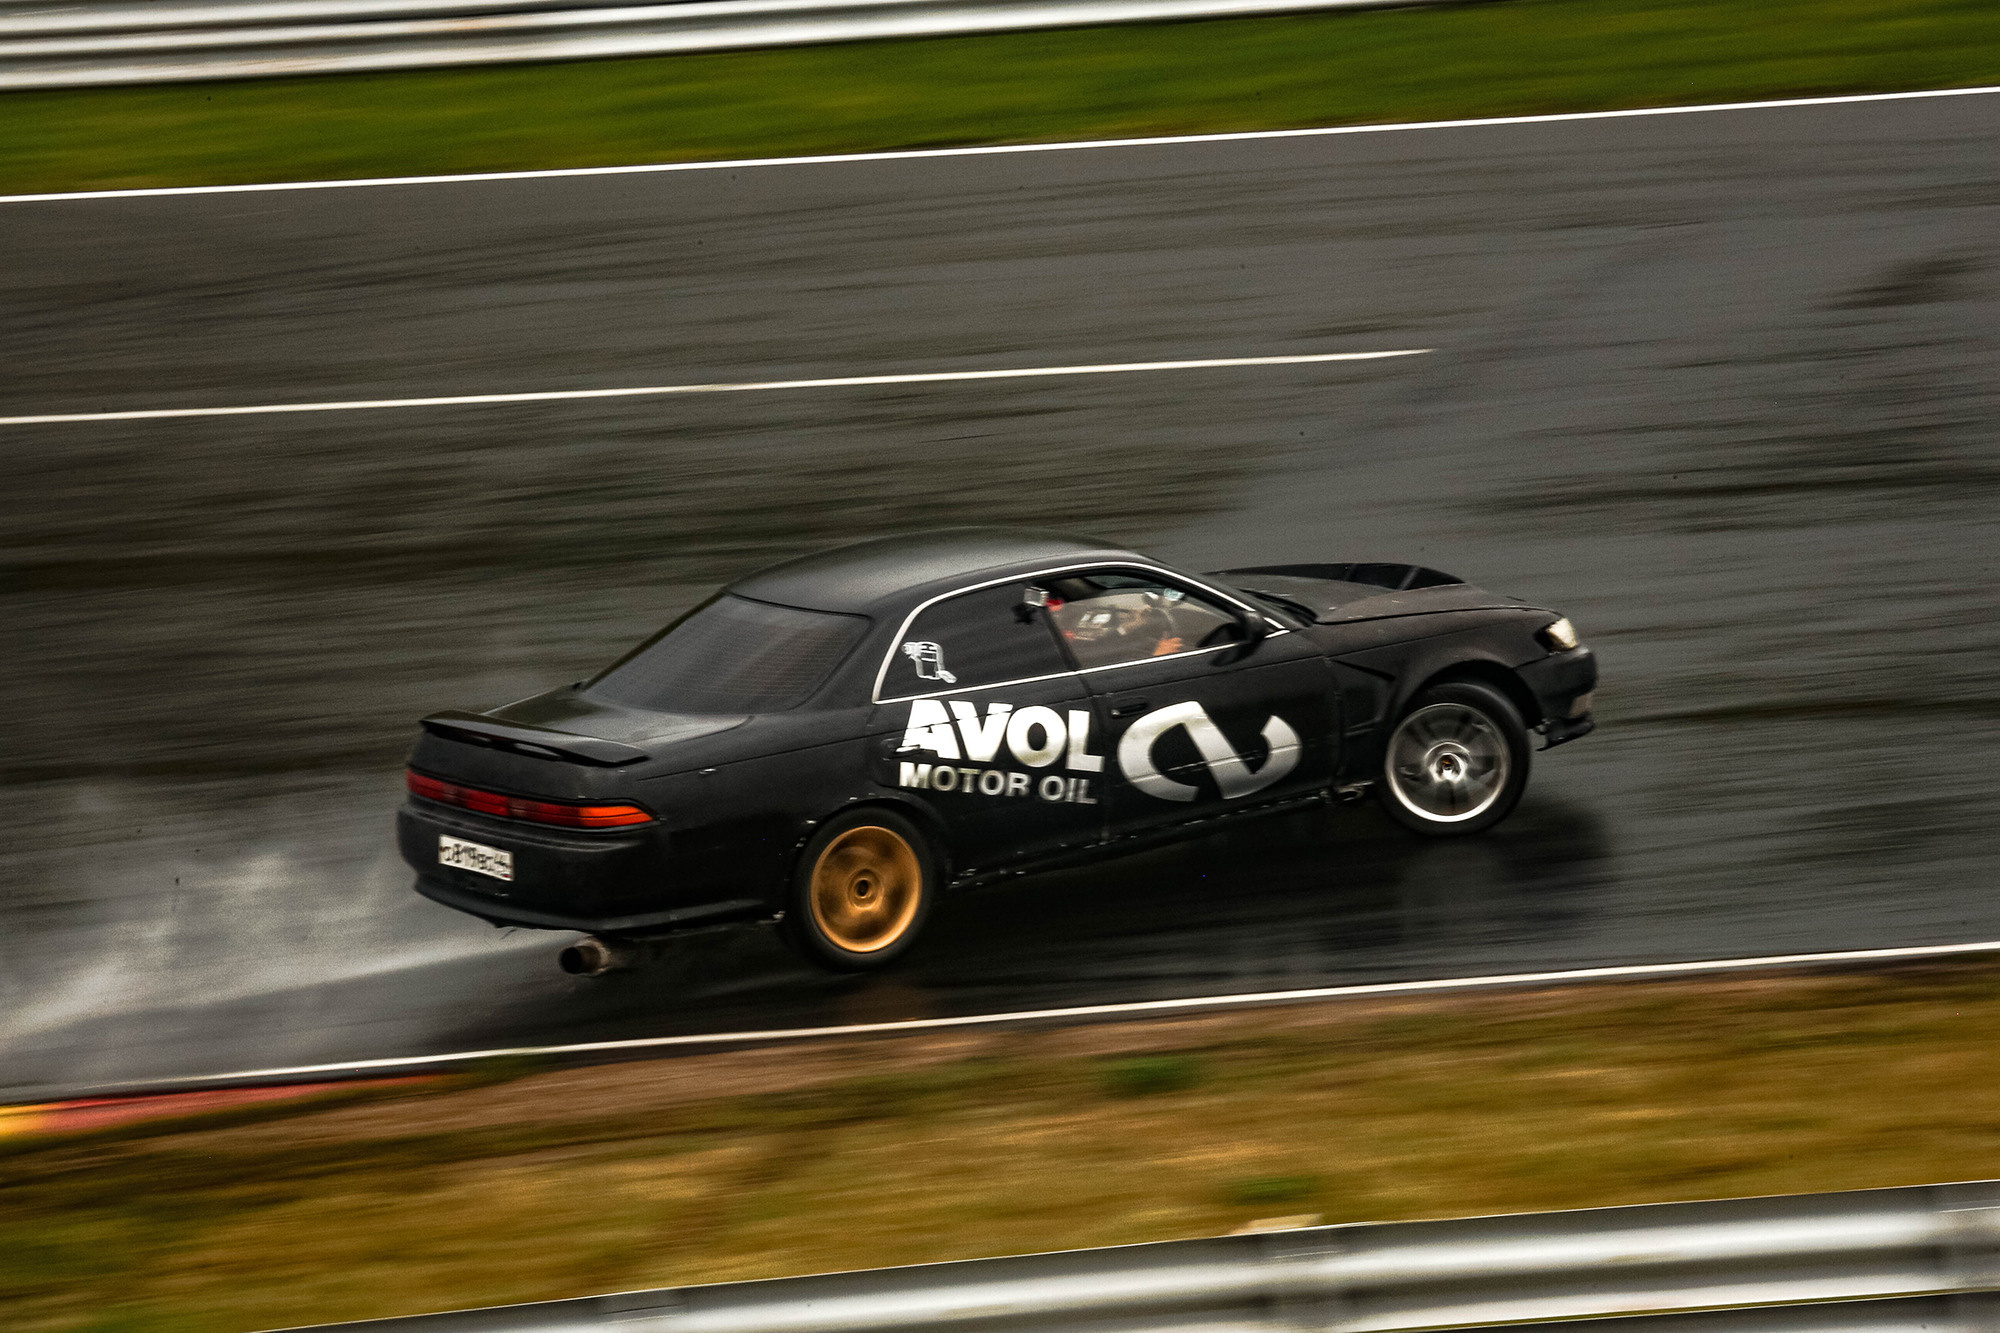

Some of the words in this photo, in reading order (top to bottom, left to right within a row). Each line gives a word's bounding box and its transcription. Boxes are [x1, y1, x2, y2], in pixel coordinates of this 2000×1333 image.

[896, 700, 1105, 772] AVOL
[899, 761, 1032, 797] MOTOR
[1038, 775, 1098, 804] OIL
